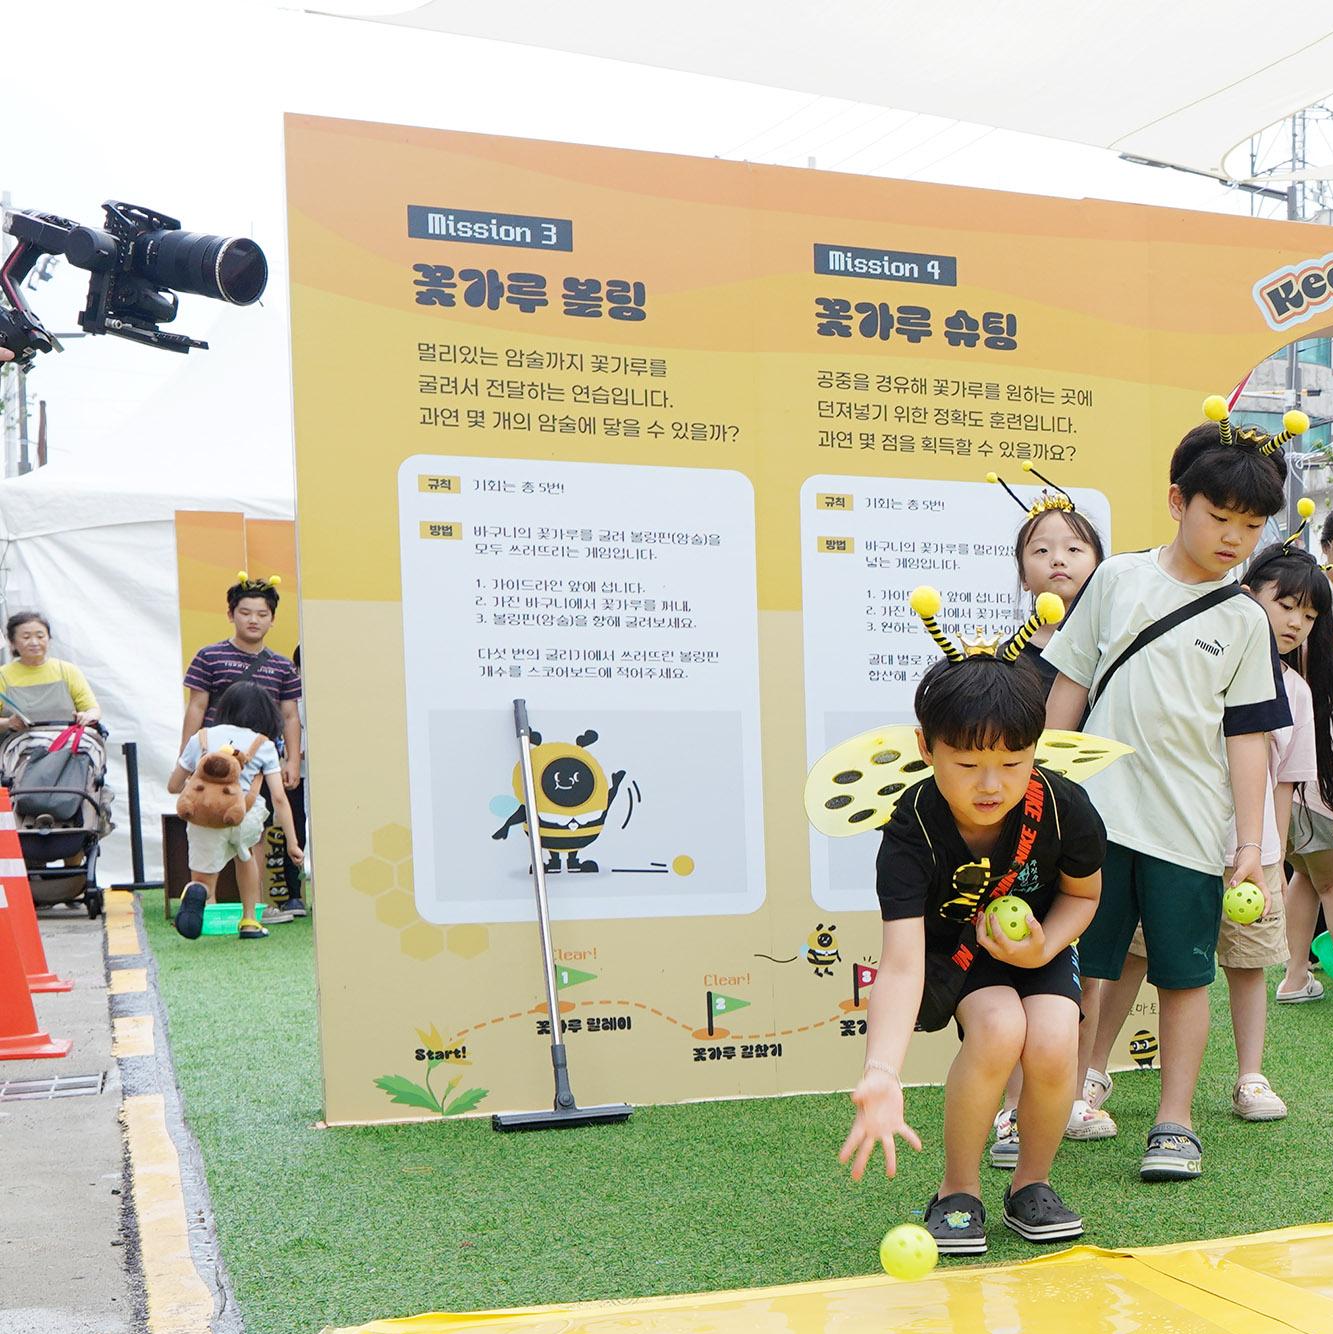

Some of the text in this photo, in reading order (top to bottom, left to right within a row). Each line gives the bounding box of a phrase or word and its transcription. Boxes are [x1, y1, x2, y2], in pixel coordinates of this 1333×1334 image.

[428, 214, 557, 245] Mission 3
[829, 250, 940, 279] Mission 4
[412, 263, 647, 321] 꽃가루 볼링
[815, 297, 1017, 350] 꽃가루 슈팅
[418, 342, 668, 378] 멀리있는 암술까지 꽃가루를
[418, 374, 674, 409] 굴려서 전달하는 연습입니다.
[817, 370, 1093, 406] 공중을 경유해 꽃가루를 원하는 곳에
[818, 401, 1077, 434] 던져넣기 위한 정확도 훈련입니다.
[419, 408, 739, 443] 과연 몇 개의 암술에 닿을 수 있을까?
[818, 430, 1076, 462] 과연 몇 점을 획득할 수 있을까요?
[428, 478, 451, 490] 규칙
[473, 479, 565, 495] 기회는 총 5번!
[825, 496, 845, 507] 규칙
[865, 498, 945, 512] 기회는 총 5번!
[429, 525, 452, 537] 방법
[473, 526, 721, 546] 바구니의 꽃가루를 굴려 볼링핀(암술)을
[474, 543, 657, 560] 모두 쓰러뜨리는 게임입니다.
[825, 539, 846, 551] 방법
[865, 540, 916, 552] 바구니의
[920, 542, 969, 555] 꽃가루를
[865, 557, 960, 570] 넣는 게임입니다.
[476, 579, 646, 595] 1. 가이드라인 앞에 섭니다.
[475, 596, 487, 607] 2.
[493, 596, 520, 608] 가진
[526, 597, 596, 610] 바구니에서
[602, 599, 655, 612] 꽃가루를
[867, 590, 876, 599] 1.
[947, 591, 972, 603] 앞에
[866, 606, 876, 616] 2.
[881, 605, 906, 618] 가진
[476, 614, 696, 629] 3. 볼링핀(암술)을 향해 굴려보세요.
[867, 622, 876, 632] 3.
[881, 622, 918, 634] 원하는
[478, 648, 720, 664] 다섯 번의 굴리기에서 쓰러뜨린 볼링핀
[897, 655, 922, 665] 별로
[479, 666, 688, 680] 개수를 스코어보드에 적어주세요.
[869, 671, 906, 681] 합산해
[561, 971, 569, 984] 1
[703, 973, 751, 987] Clear!
[414, 1047, 467, 1062] Start!
[693, 1047, 736, 1063] 꽃가루
